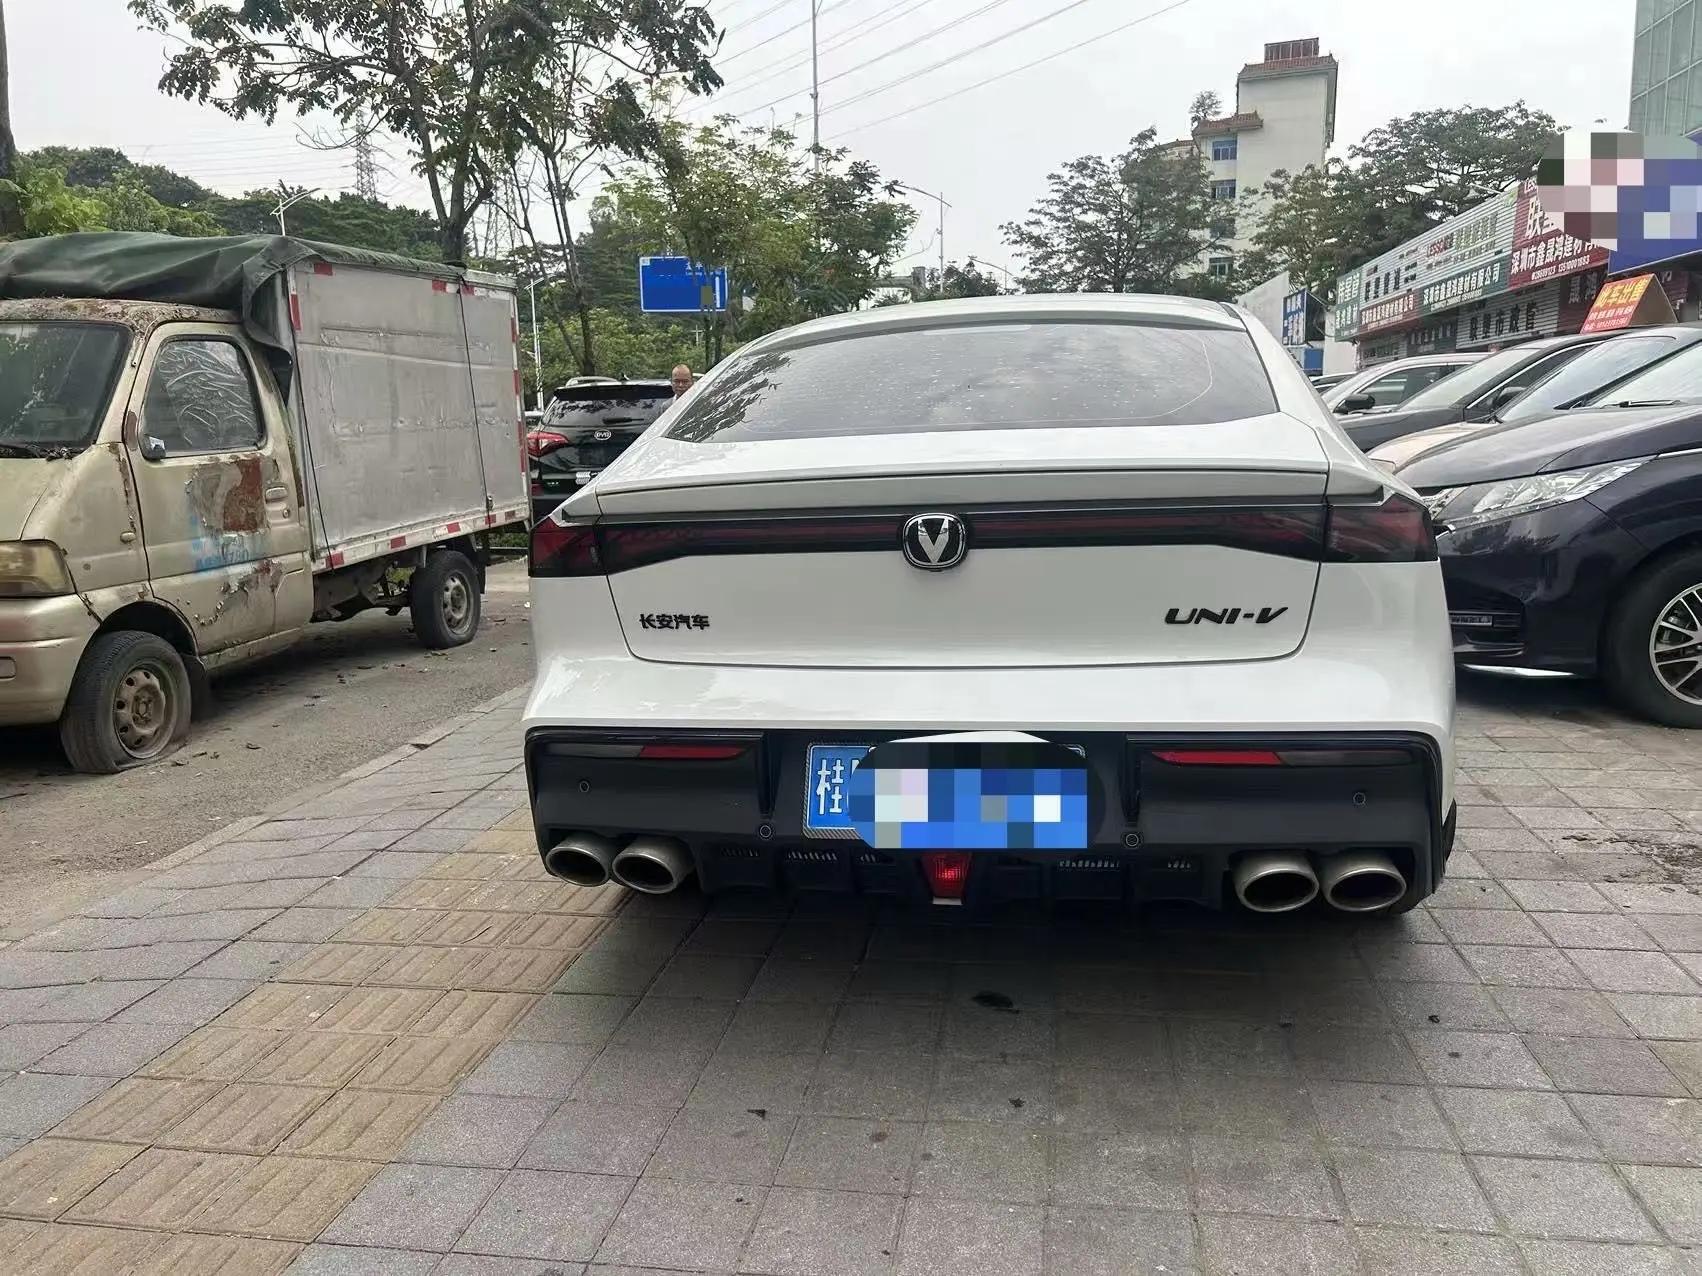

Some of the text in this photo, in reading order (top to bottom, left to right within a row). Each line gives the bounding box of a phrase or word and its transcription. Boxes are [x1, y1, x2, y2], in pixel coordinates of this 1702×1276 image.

[639, 613, 710, 630] 长安汽车
[1164, 606, 1289, 624] UNI-V
